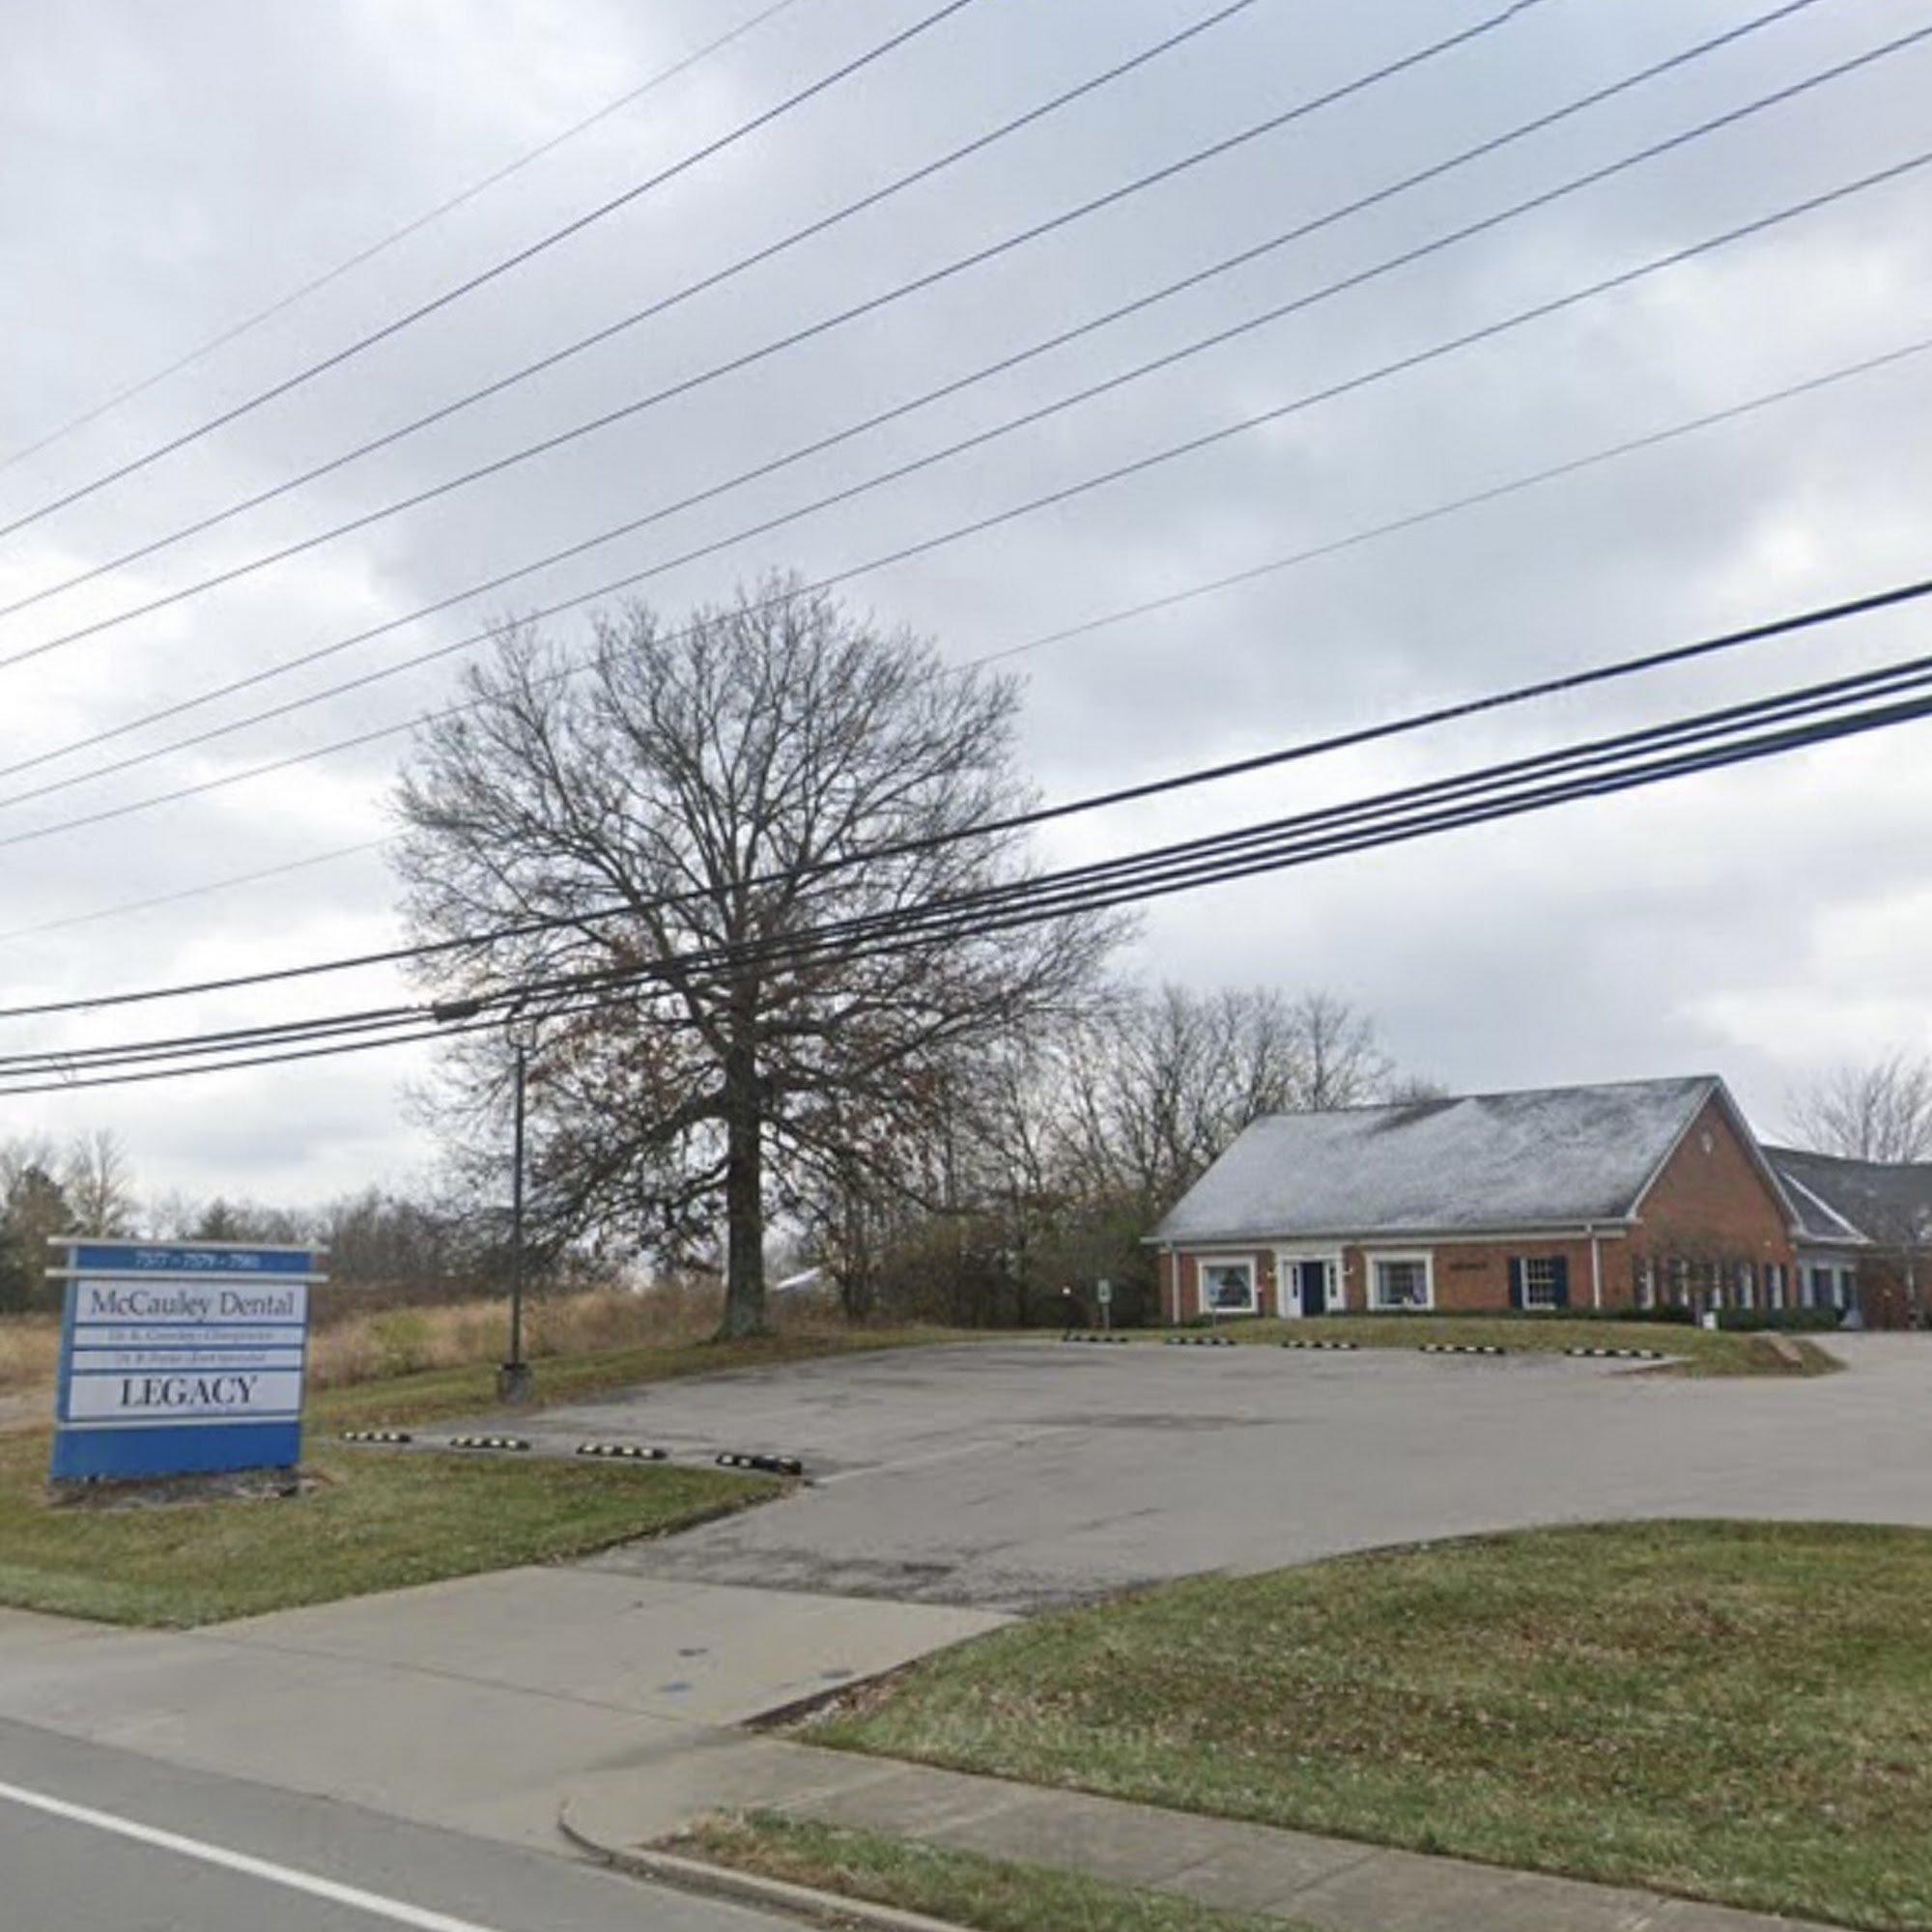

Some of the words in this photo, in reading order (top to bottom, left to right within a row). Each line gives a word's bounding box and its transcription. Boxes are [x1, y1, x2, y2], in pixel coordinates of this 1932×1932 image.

[91, 1290, 212, 1321] McCauley
[220, 1291, 294, 1316] Dental
[121, 1376, 258, 1406] LEGACY
